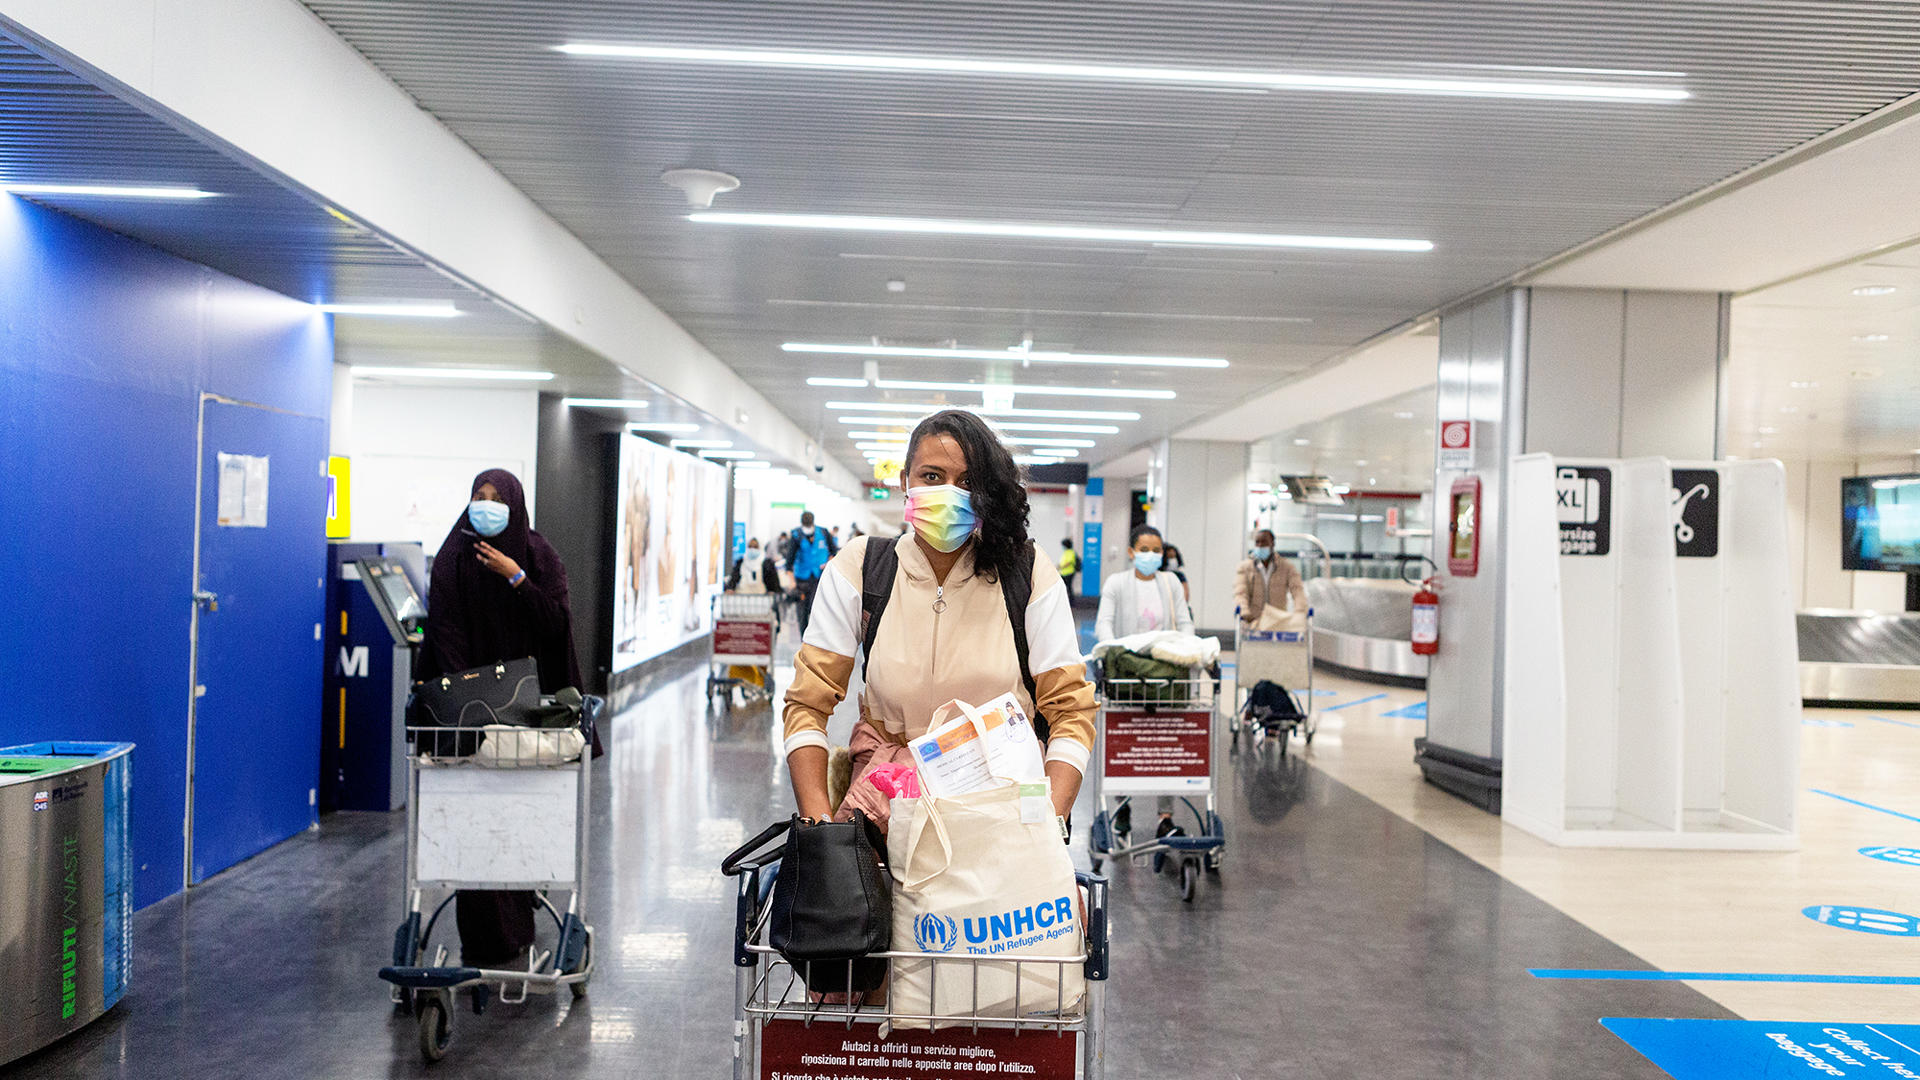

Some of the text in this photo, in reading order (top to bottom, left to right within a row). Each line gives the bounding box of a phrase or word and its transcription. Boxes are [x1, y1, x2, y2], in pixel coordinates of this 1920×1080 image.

[1557, 489, 1581, 508] XL
[963, 896, 1073, 944] UNHCR
[989, 943, 1005, 954] UN
[1007, 933, 1044, 950] Refugee
[1046, 924, 1074, 940] Agency
[61, 926, 77, 1019] RIFIUTI
[841, 1041, 996, 1059] Aiutaci a offrirti un servizio migliore,
[1765, 1033, 1846, 1077] baggage
[1808, 1042, 1866, 1067] your
[1822, 1028, 1891, 1061] Collect
[801, 1053, 847, 1066] riposiziona
[849, 1055, 855, 1066] il
[857, 1056, 890, 1067] carrello
[892, 1057, 912, 1068] nelle
[915, 1059, 951, 1071] apposite
[953, 1061, 973, 1071] aree
[975, 1061, 997, 1074] dopo
